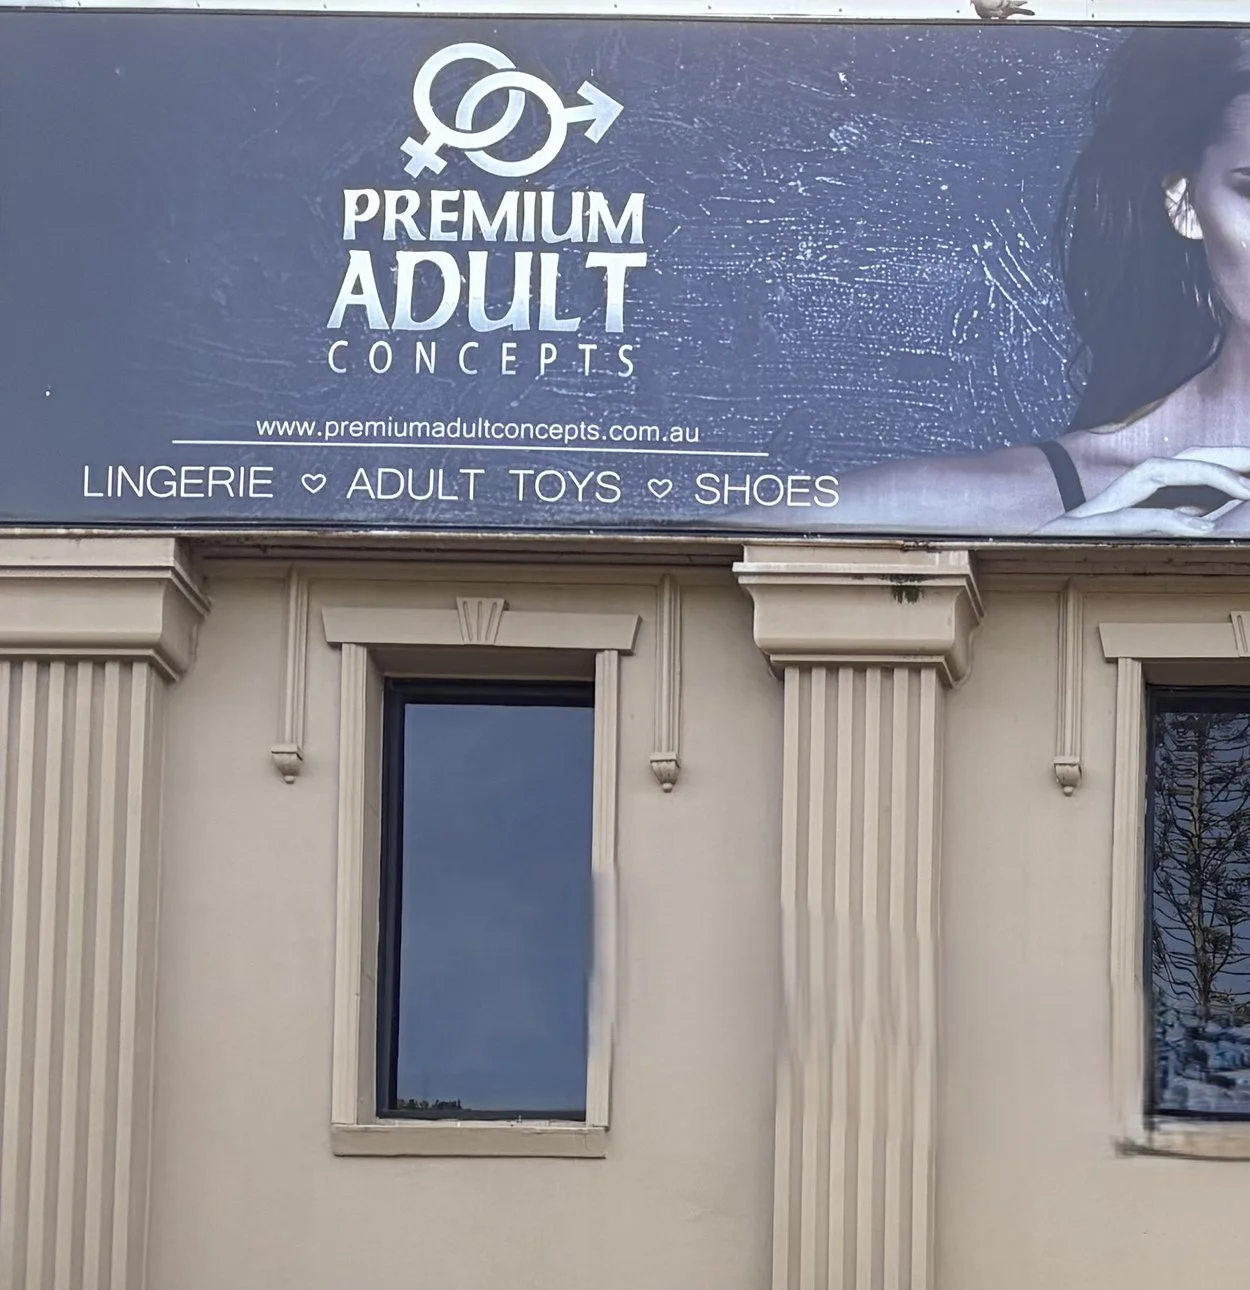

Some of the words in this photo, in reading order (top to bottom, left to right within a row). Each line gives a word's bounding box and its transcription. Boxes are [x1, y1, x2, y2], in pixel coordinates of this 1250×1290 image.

[343, 188, 646, 244] PREMIUM
[326, 249, 648, 333] ADULT
[327, 340, 635, 378] CONCEPTS
[255, 416, 700, 444] www.premiumadultconcepts.com.au
[83, 464, 275, 498] LINGERIE
[346, 467, 486, 501] ADULT
[508, 469, 622, 503] TOYS
[694, 472, 840, 508] SHOES
